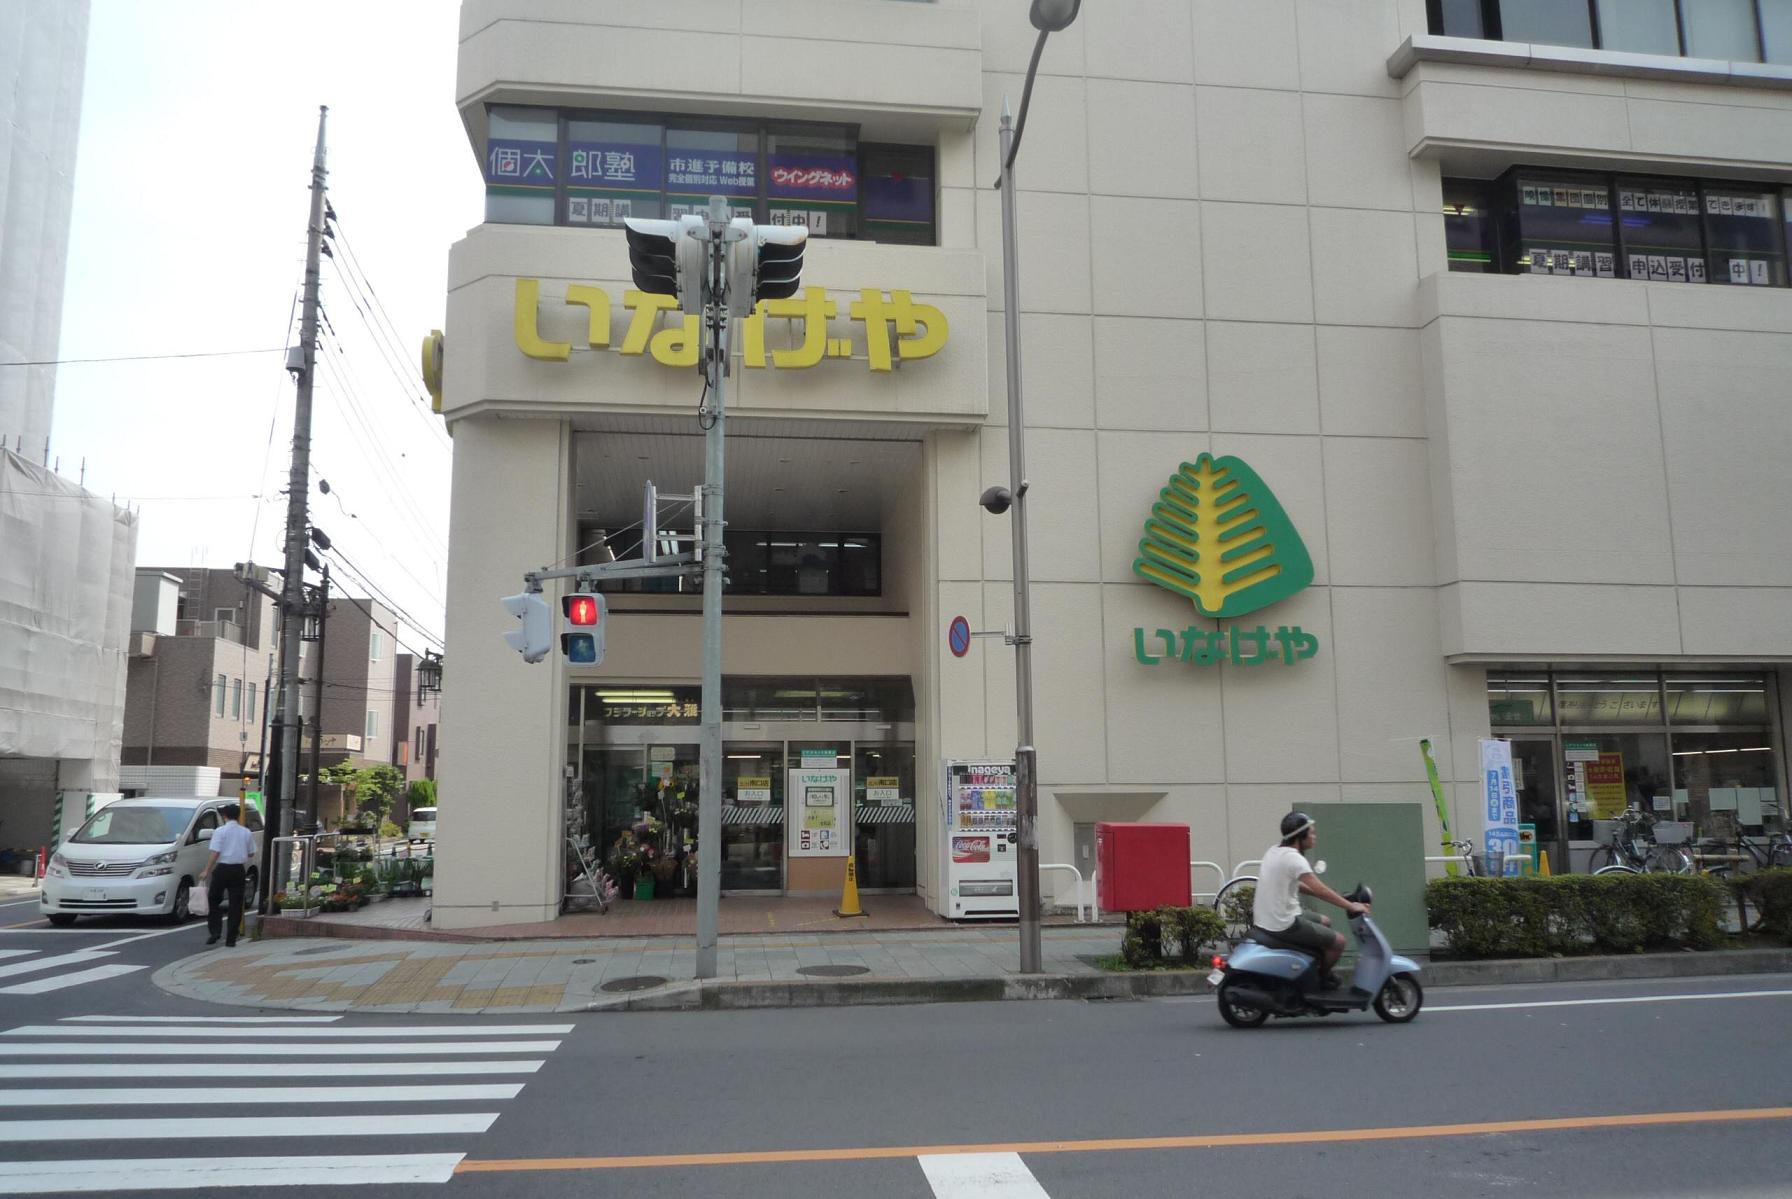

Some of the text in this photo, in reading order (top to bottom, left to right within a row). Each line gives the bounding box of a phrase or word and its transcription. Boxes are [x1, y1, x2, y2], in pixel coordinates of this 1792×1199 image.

[669, 158, 755, 175] 市進予備校
[774, 169, 852, 186] ウイングネット
[1632, 258, 1704, 278] 申込受付
[514, 279, 949, 372] いなげや
[1133, 626, 1319, 667] いなげや
